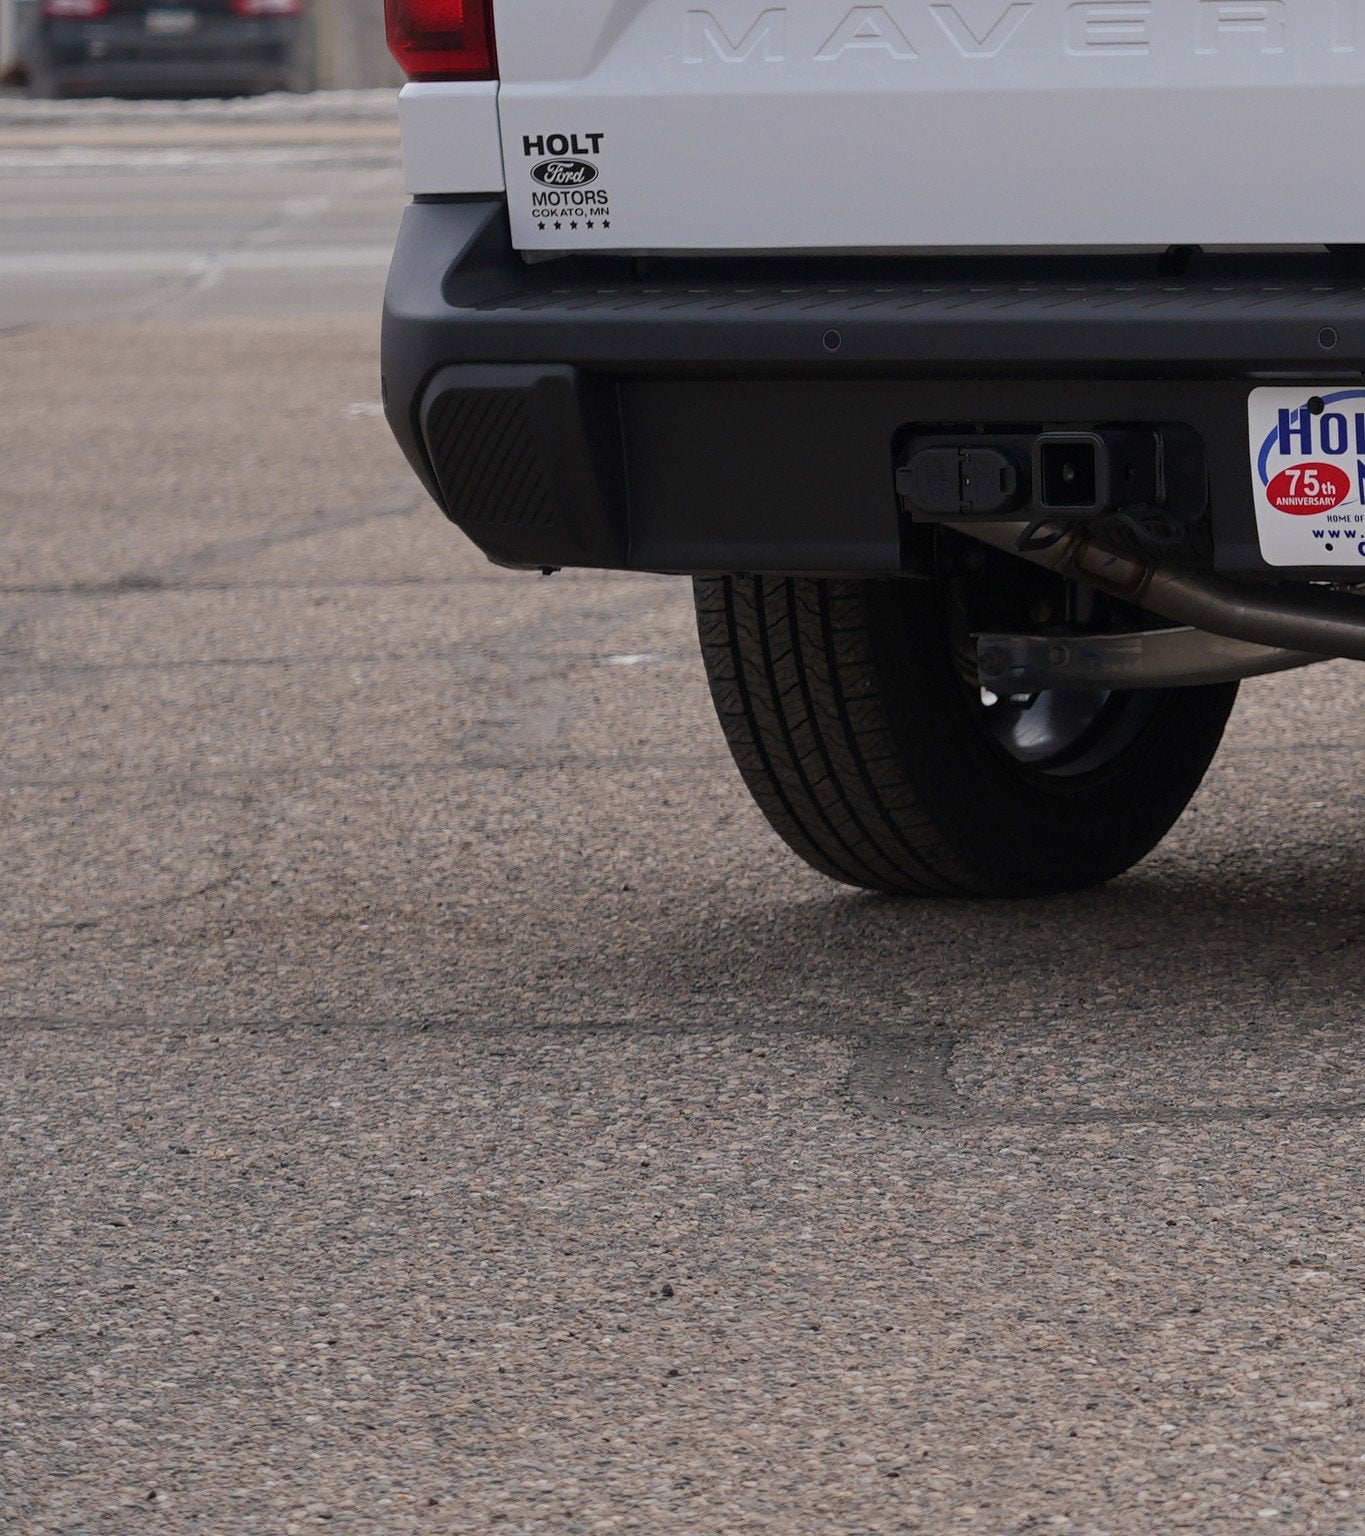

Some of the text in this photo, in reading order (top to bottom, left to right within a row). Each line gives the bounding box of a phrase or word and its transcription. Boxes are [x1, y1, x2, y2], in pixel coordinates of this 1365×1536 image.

[522, 133, 604, 156] HOLT
[544, 162, 586, 184] Ford
[531, 189, 609, 206] MOTORS
[532, 207, 610, 219] COKATO, MN
[1285, 469, 1337, 496] 75th
[1275, 496, 1337, 507] ANNIVERSARY
[1327, 514, 1352, 523] HOME
[1354, 514, 1365, 523] OF
